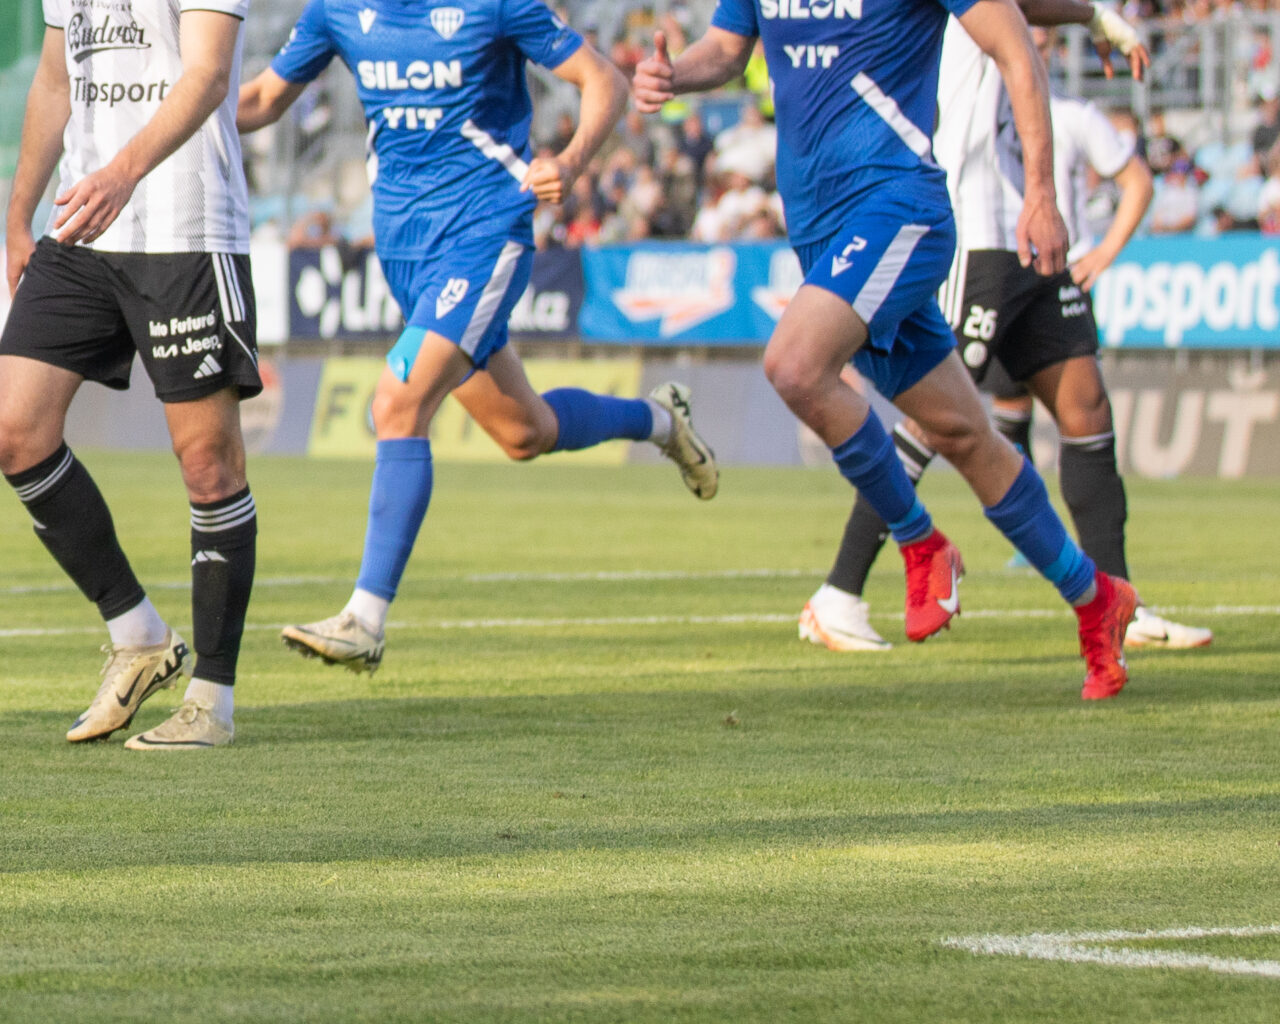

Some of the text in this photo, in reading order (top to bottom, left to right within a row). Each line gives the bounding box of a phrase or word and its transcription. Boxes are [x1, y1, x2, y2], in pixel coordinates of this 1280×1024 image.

[783, 45, 840, 69] YIT
[357, 60, 463, 90] SILON
[73, 76, 169, 108] Tipsport
[383, 107, 443, 130] YIT
[1096, 247, 1280, 347] ipsport
[963, 304, 998, 341] 26
